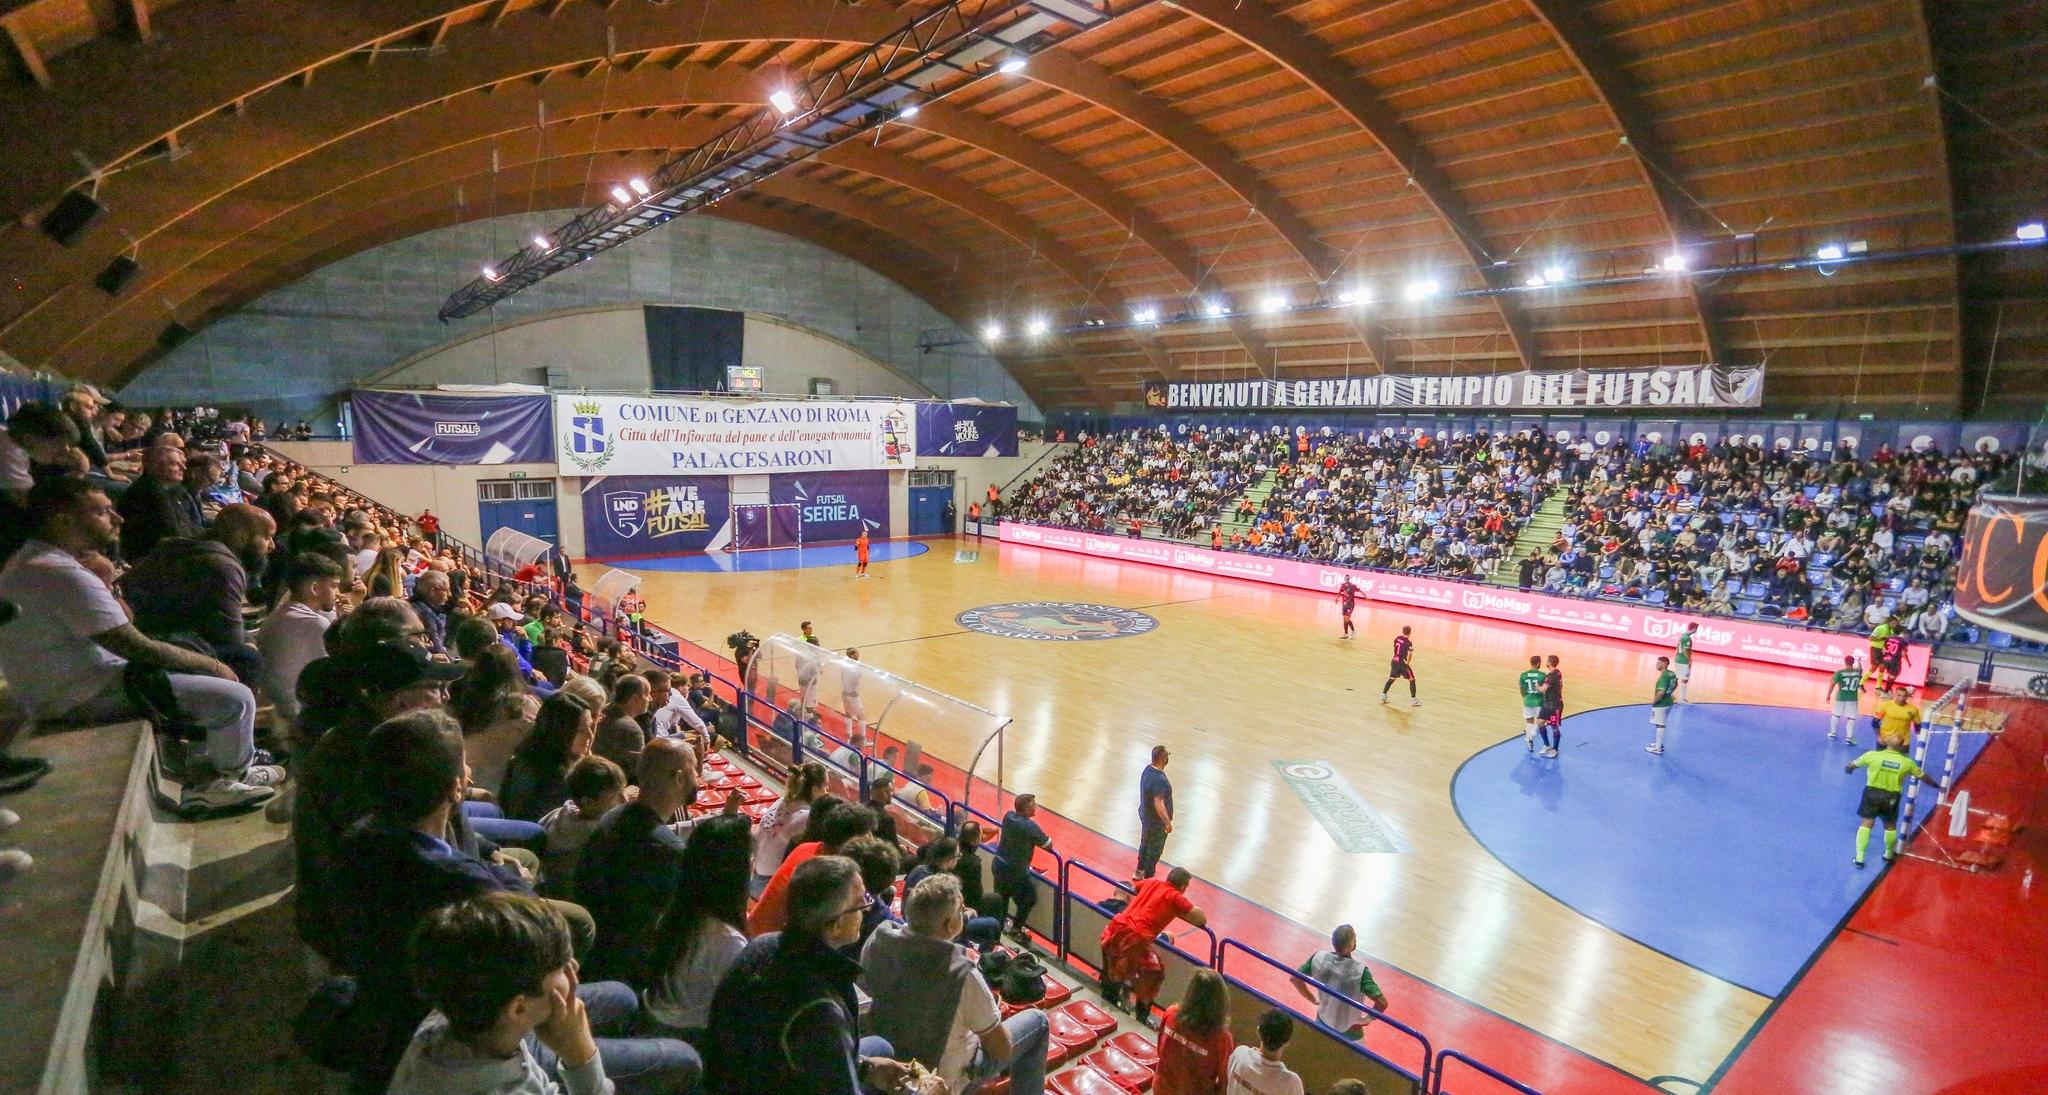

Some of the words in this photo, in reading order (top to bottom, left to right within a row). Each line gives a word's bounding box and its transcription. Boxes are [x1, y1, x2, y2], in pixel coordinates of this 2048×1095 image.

[1168, 382, 1268, 407] BENVENUTI
[1274, 380, 1286, 406] A
[1294, 377, 1396, 406] GENZANO
[1410, 376, 1513, 406] TEMPIO
[1522, 375, 1575, 405] DEL
[1586, 369, 1715, 405] FUTSAL
[619, 403, 700, 423] COMUNE
[722, 408, 801, 424] GENZANO
[806, 409, 821, 423] DI
[827, 408, 871, 423] ROMA
[437, 423, 476, 434] FUTSAL
[619, 427, 647, 441] Città
[650, 428, 722, 446] dell'Infiorata
[725, 431, 741, 443] del
[742, 432, 767, 446] pane
[769, 432, 775, 442] e
[672, 449, 833, 469] PALACESARONI
[613, 500, 639, 512] LND
[666, 500, 706, 515] ARE
[816, 494, 847, 505] FUTSAL
[803, 505, 847, 523] SERIE
[848, 504, 860, 520] A
[646, 513, 708, 536] FUTSAL
[1484, 594, 1531, 615] MoMap
[1671, 622, 1732, 646] MMap
